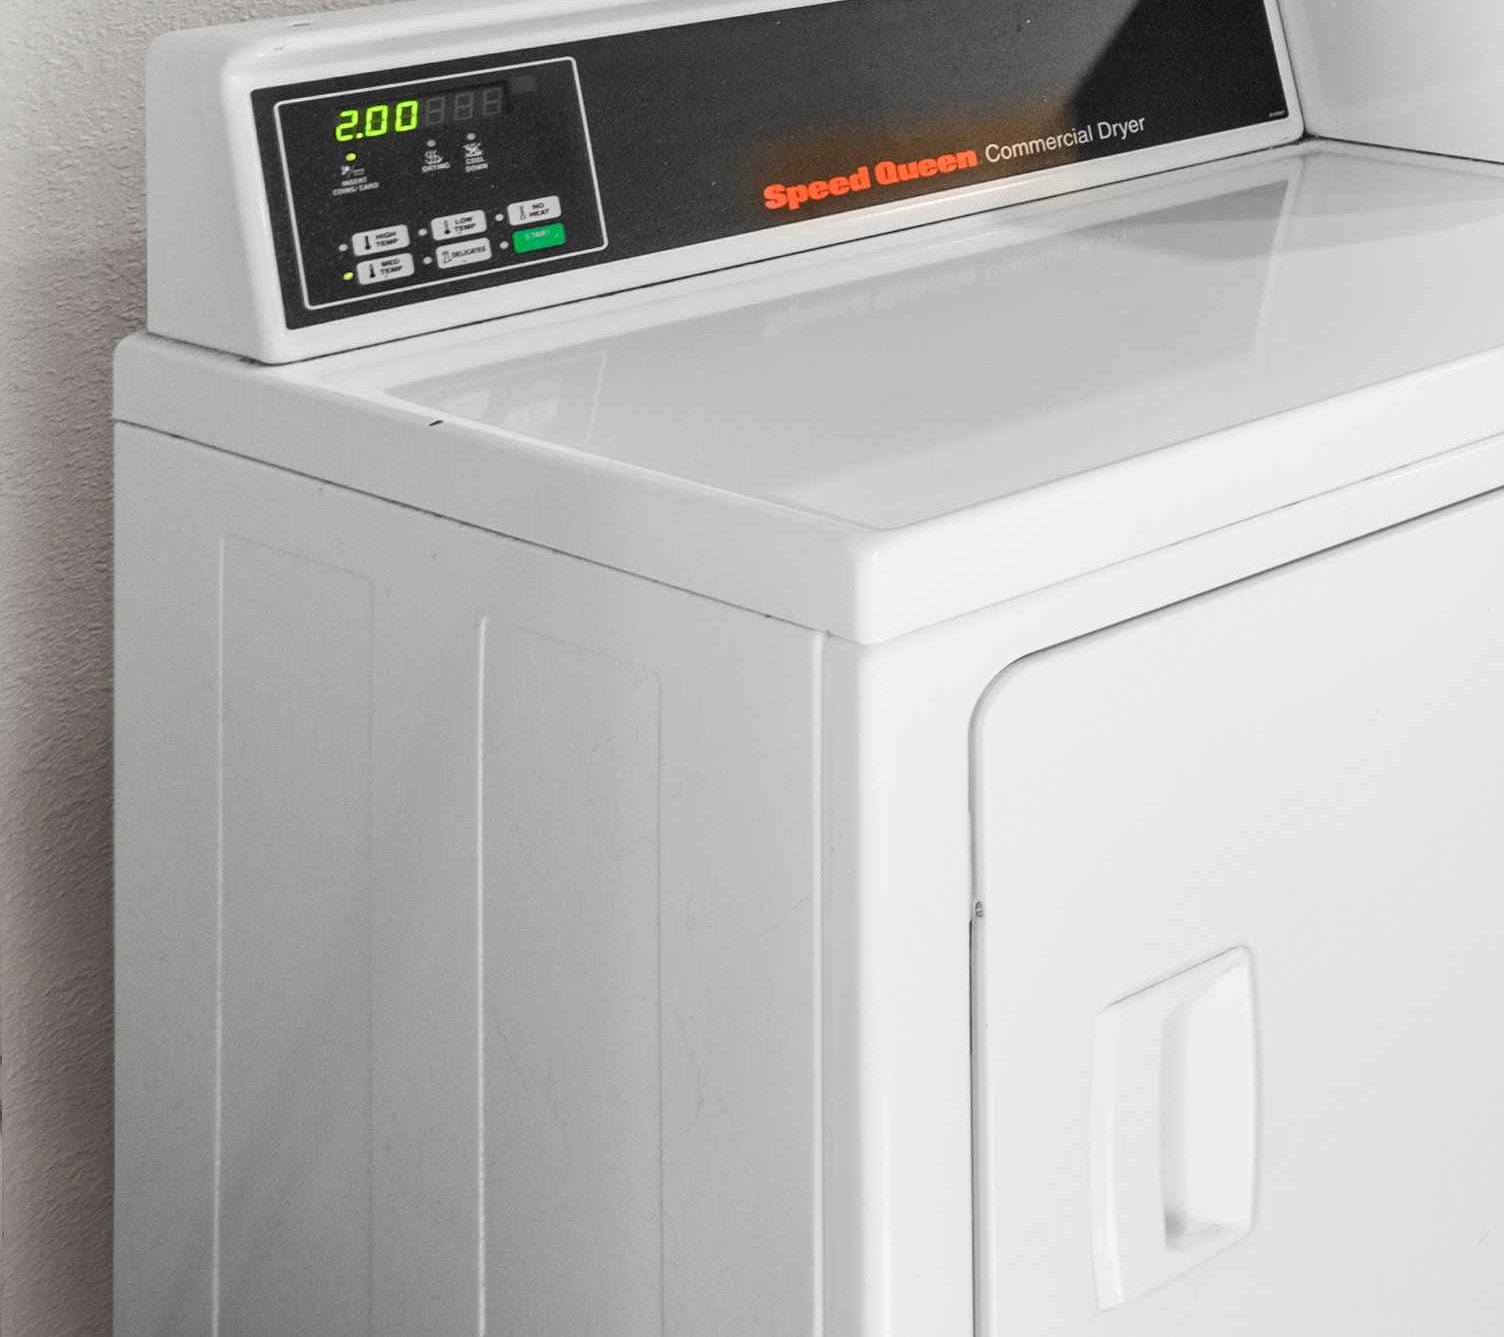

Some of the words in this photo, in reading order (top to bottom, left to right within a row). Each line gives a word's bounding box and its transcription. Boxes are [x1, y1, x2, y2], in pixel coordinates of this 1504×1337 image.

[335, 99, 419, 141] 2.00
[762, 166, 871, 212] Speed
[875, 148, 979, 187] Queen
[984, 124, 1093, 165] Commercial
[1097, 114, 1147, 146] Dryer
[375, 230, 397, 240] HIGH
[375, 237, 399, 247] TEMP
[451, 244, 487, 258] DELICATES
[381, 258, 401, 268] MED
[380, 264, 403, 275] TEMP
